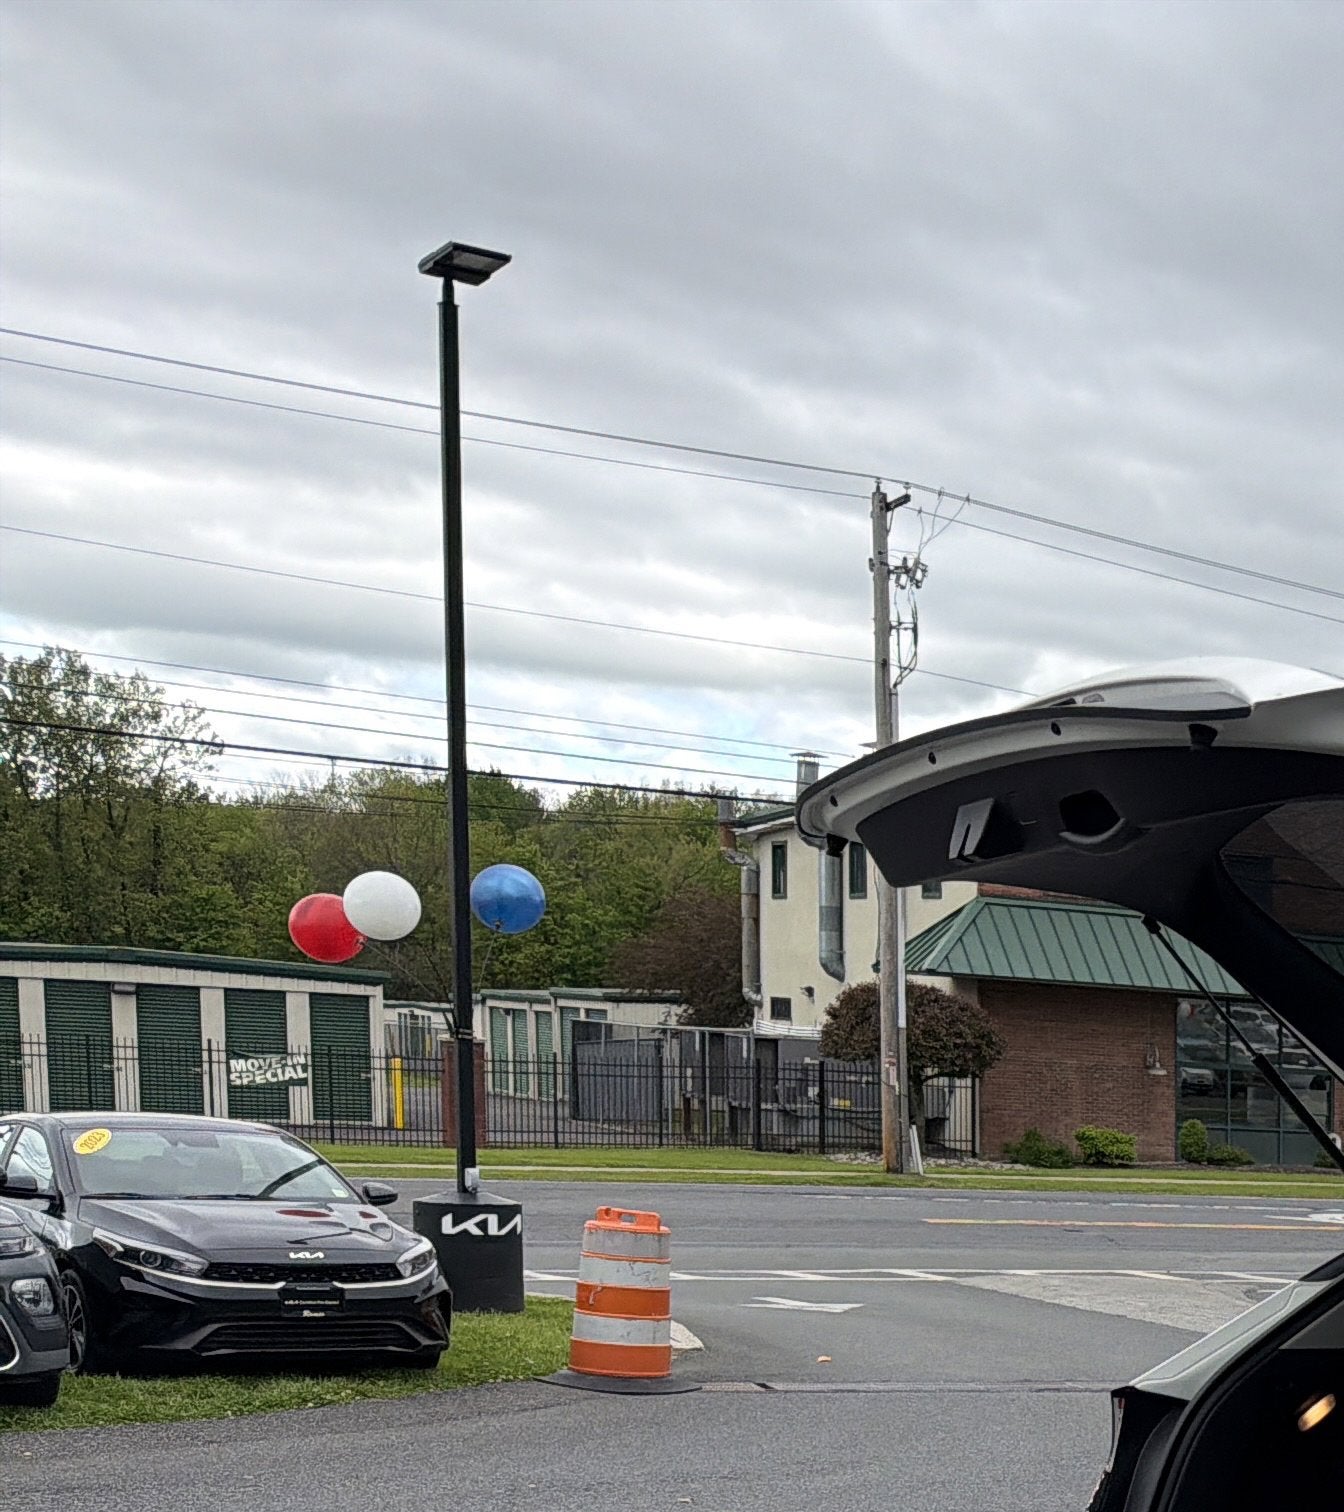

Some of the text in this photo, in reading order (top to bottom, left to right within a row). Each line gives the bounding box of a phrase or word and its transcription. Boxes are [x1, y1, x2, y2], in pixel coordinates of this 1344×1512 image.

[229, 1054, 306, 1073] MOVE-IN
[229, 1065, 308, 1086] SPECIAL
[441, 1212, 522, 1236] KIA
[288, 1251, 325, 1259] KIA
